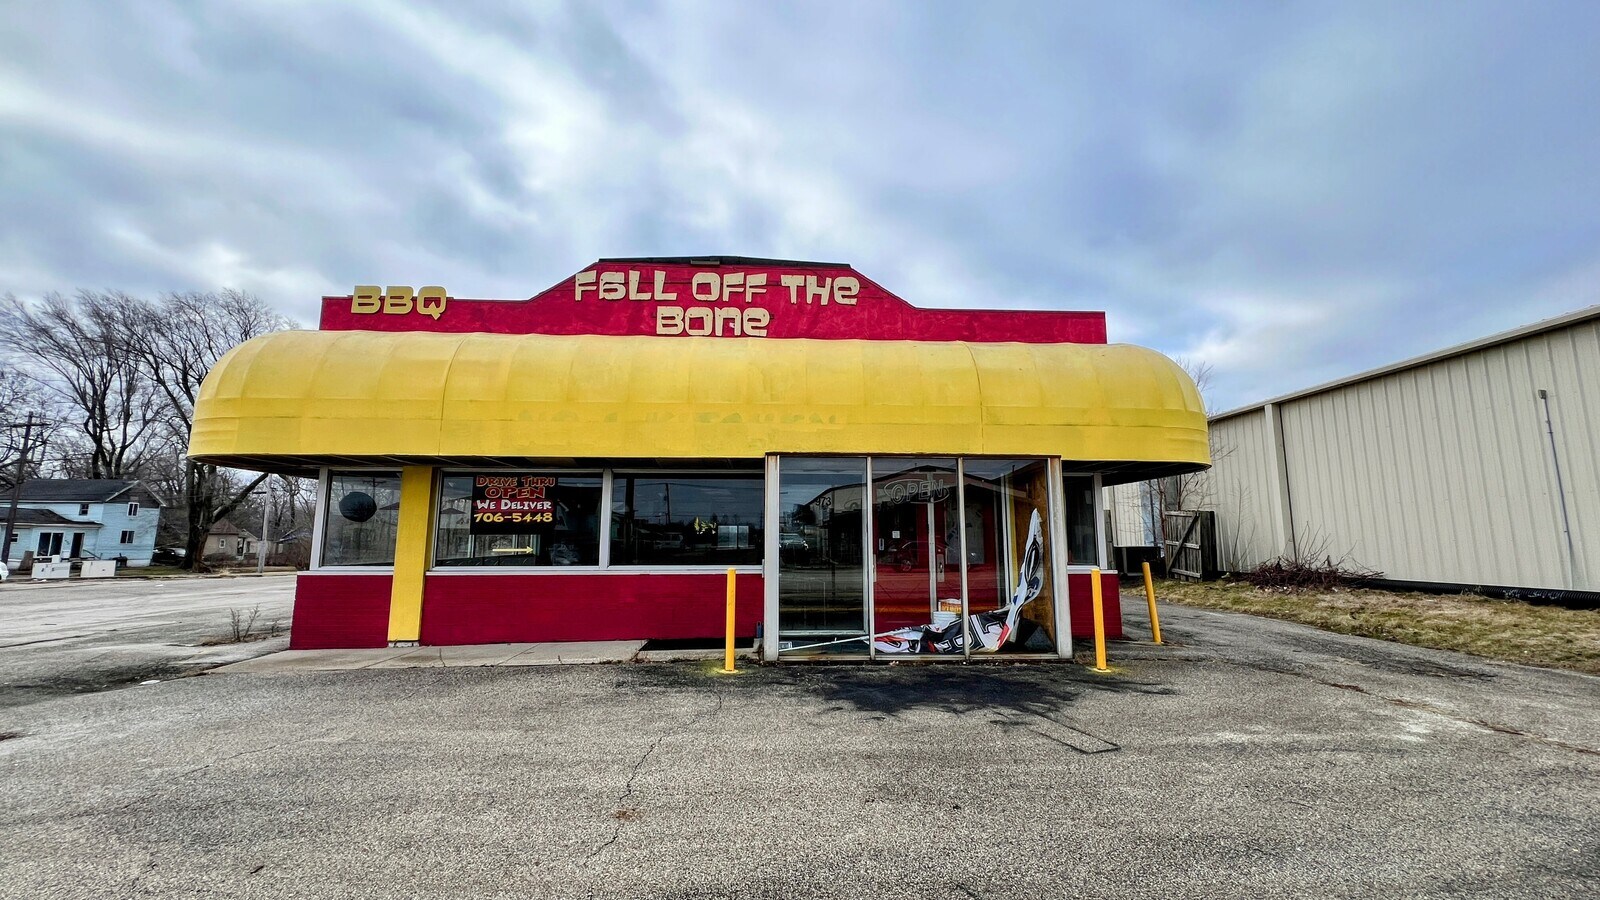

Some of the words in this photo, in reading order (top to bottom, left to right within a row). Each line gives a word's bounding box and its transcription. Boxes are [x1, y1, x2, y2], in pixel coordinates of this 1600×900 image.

[692, 272, 767, 302] OFF
[350, 286, 447, 320] BBQ
[476, 475, 517, 487] DRIVE
[521, 475, 555, 487] THRU
[485, 486, 545, 498] OPEN
[891, 479, 944, 504] OPEN
[476, 500, 496, 509] WE
[501, 499, 552, 510] DELIVER
[473, 512, 553, 522] 706-5448
